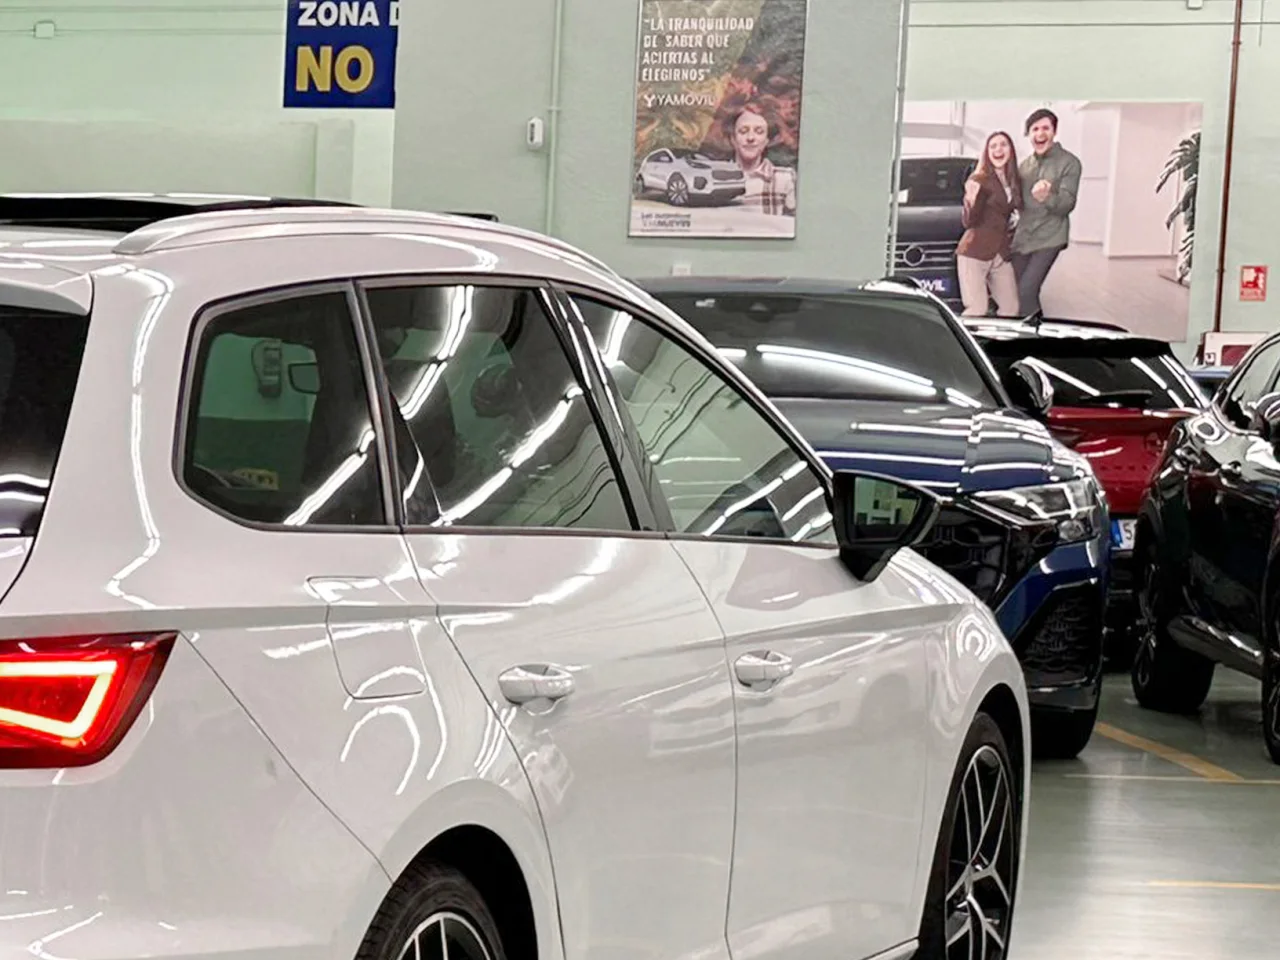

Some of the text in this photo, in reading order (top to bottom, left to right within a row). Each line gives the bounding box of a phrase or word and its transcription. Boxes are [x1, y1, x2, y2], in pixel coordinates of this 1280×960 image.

[298, 1, 380, 27] ZONA
[669, 17, 754, 33] TRANQUILIDAD
[643, 33, 730, 49] DE SABER QUE
[642, 51, 715, 65] ACIERTAS AL
[296, 45, 374, 93] NO
[657, 94, 717, 106] YAMOVIL
